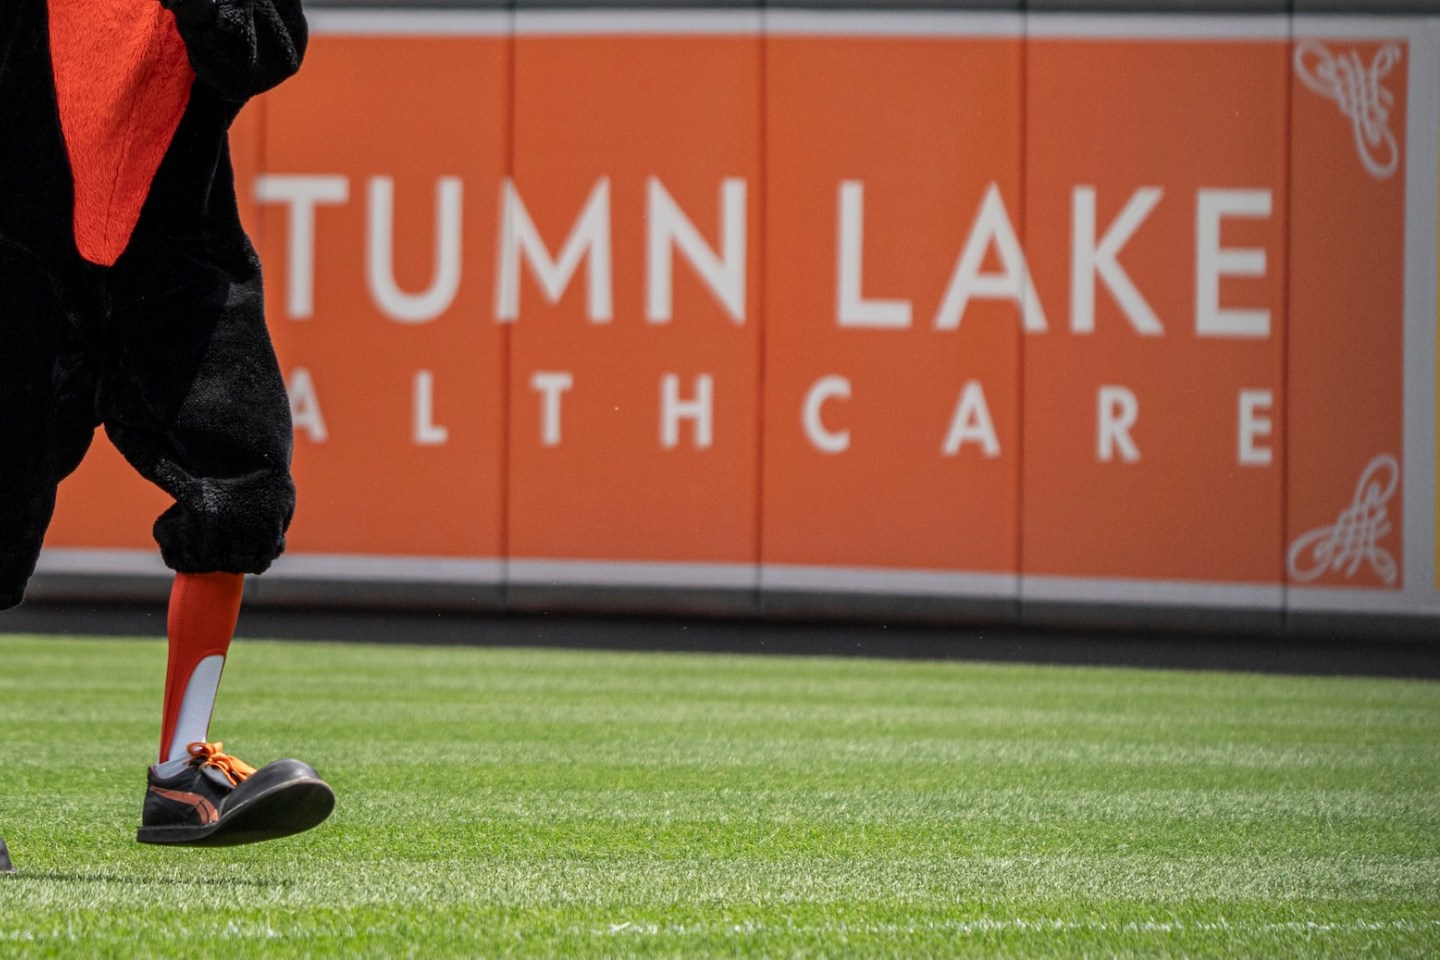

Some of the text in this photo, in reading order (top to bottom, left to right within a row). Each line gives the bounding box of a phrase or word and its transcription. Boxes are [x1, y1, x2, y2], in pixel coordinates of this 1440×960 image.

[254, 175, 1272, 338] TUMN LAKE
[289, 365, 1273, 465] ALTHCARE
